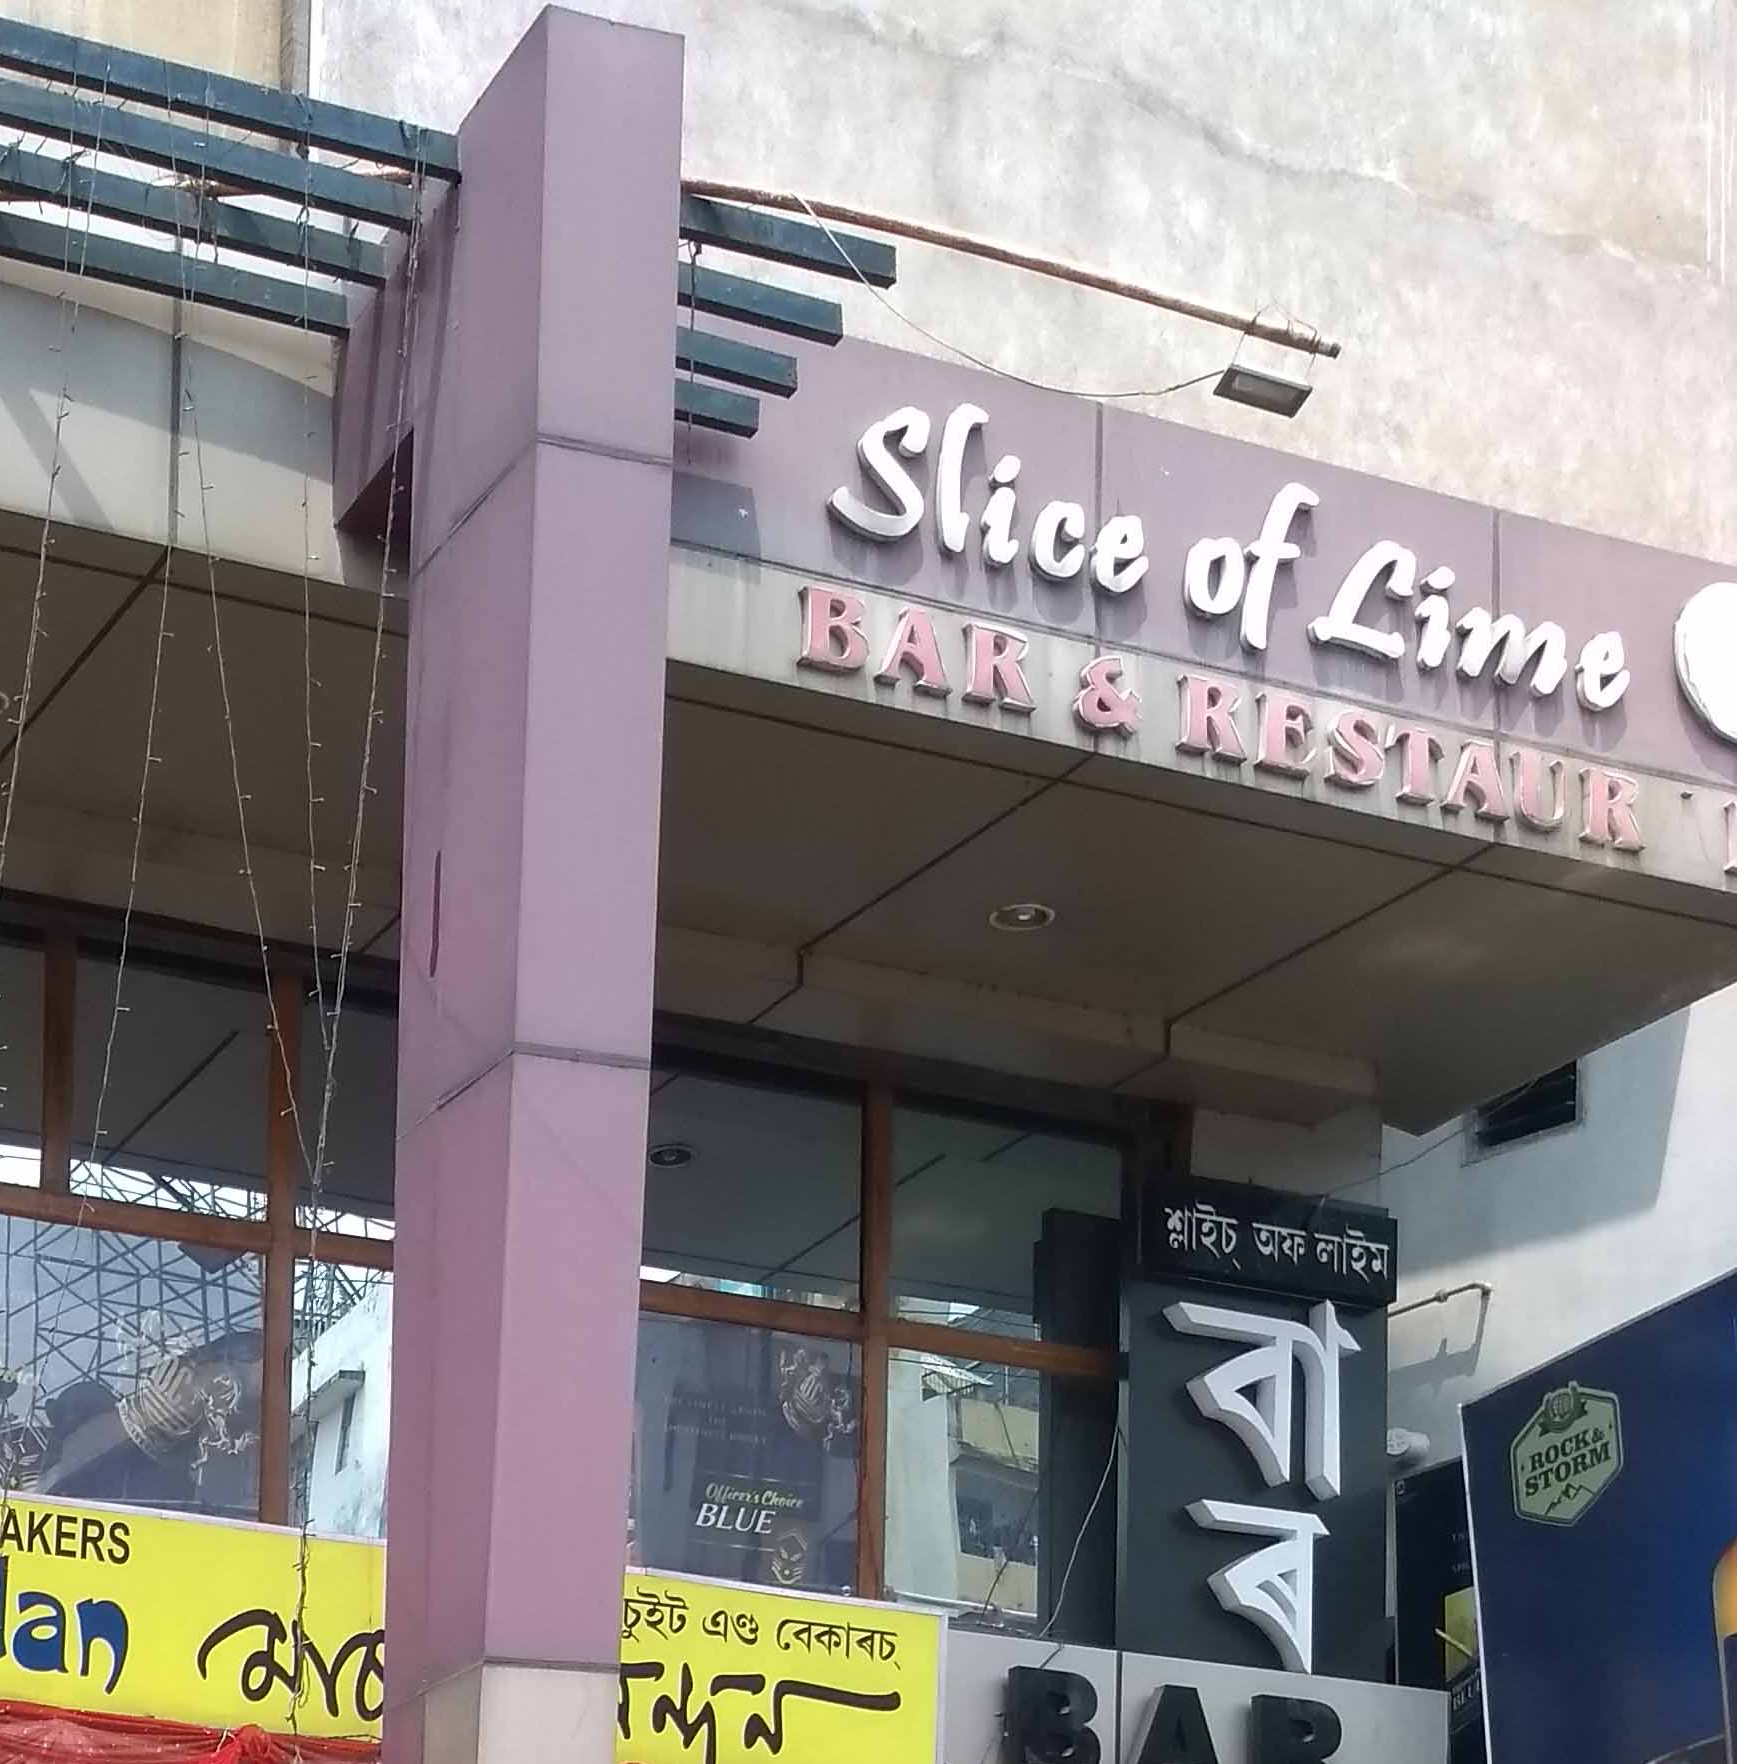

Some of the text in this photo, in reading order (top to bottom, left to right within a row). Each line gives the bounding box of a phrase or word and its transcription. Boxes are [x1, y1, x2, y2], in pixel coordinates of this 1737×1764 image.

[827, 402, 1631, 713] Slice of Lime
[797, 585, 1037, 712] BAR
[1072, 655, 1144, 738] &
[1251, 1222, 1307, 1265] অফ
[1314, 1223, 1390, 1284] লাইম
[1525, 1441, 1611, 1498] STORM
[1528, 1429, 1591, 1473] ROCK
[695, 1503, 776, 1535] BLUE
[705, 1482, 804, 1509] Officer's Choice
